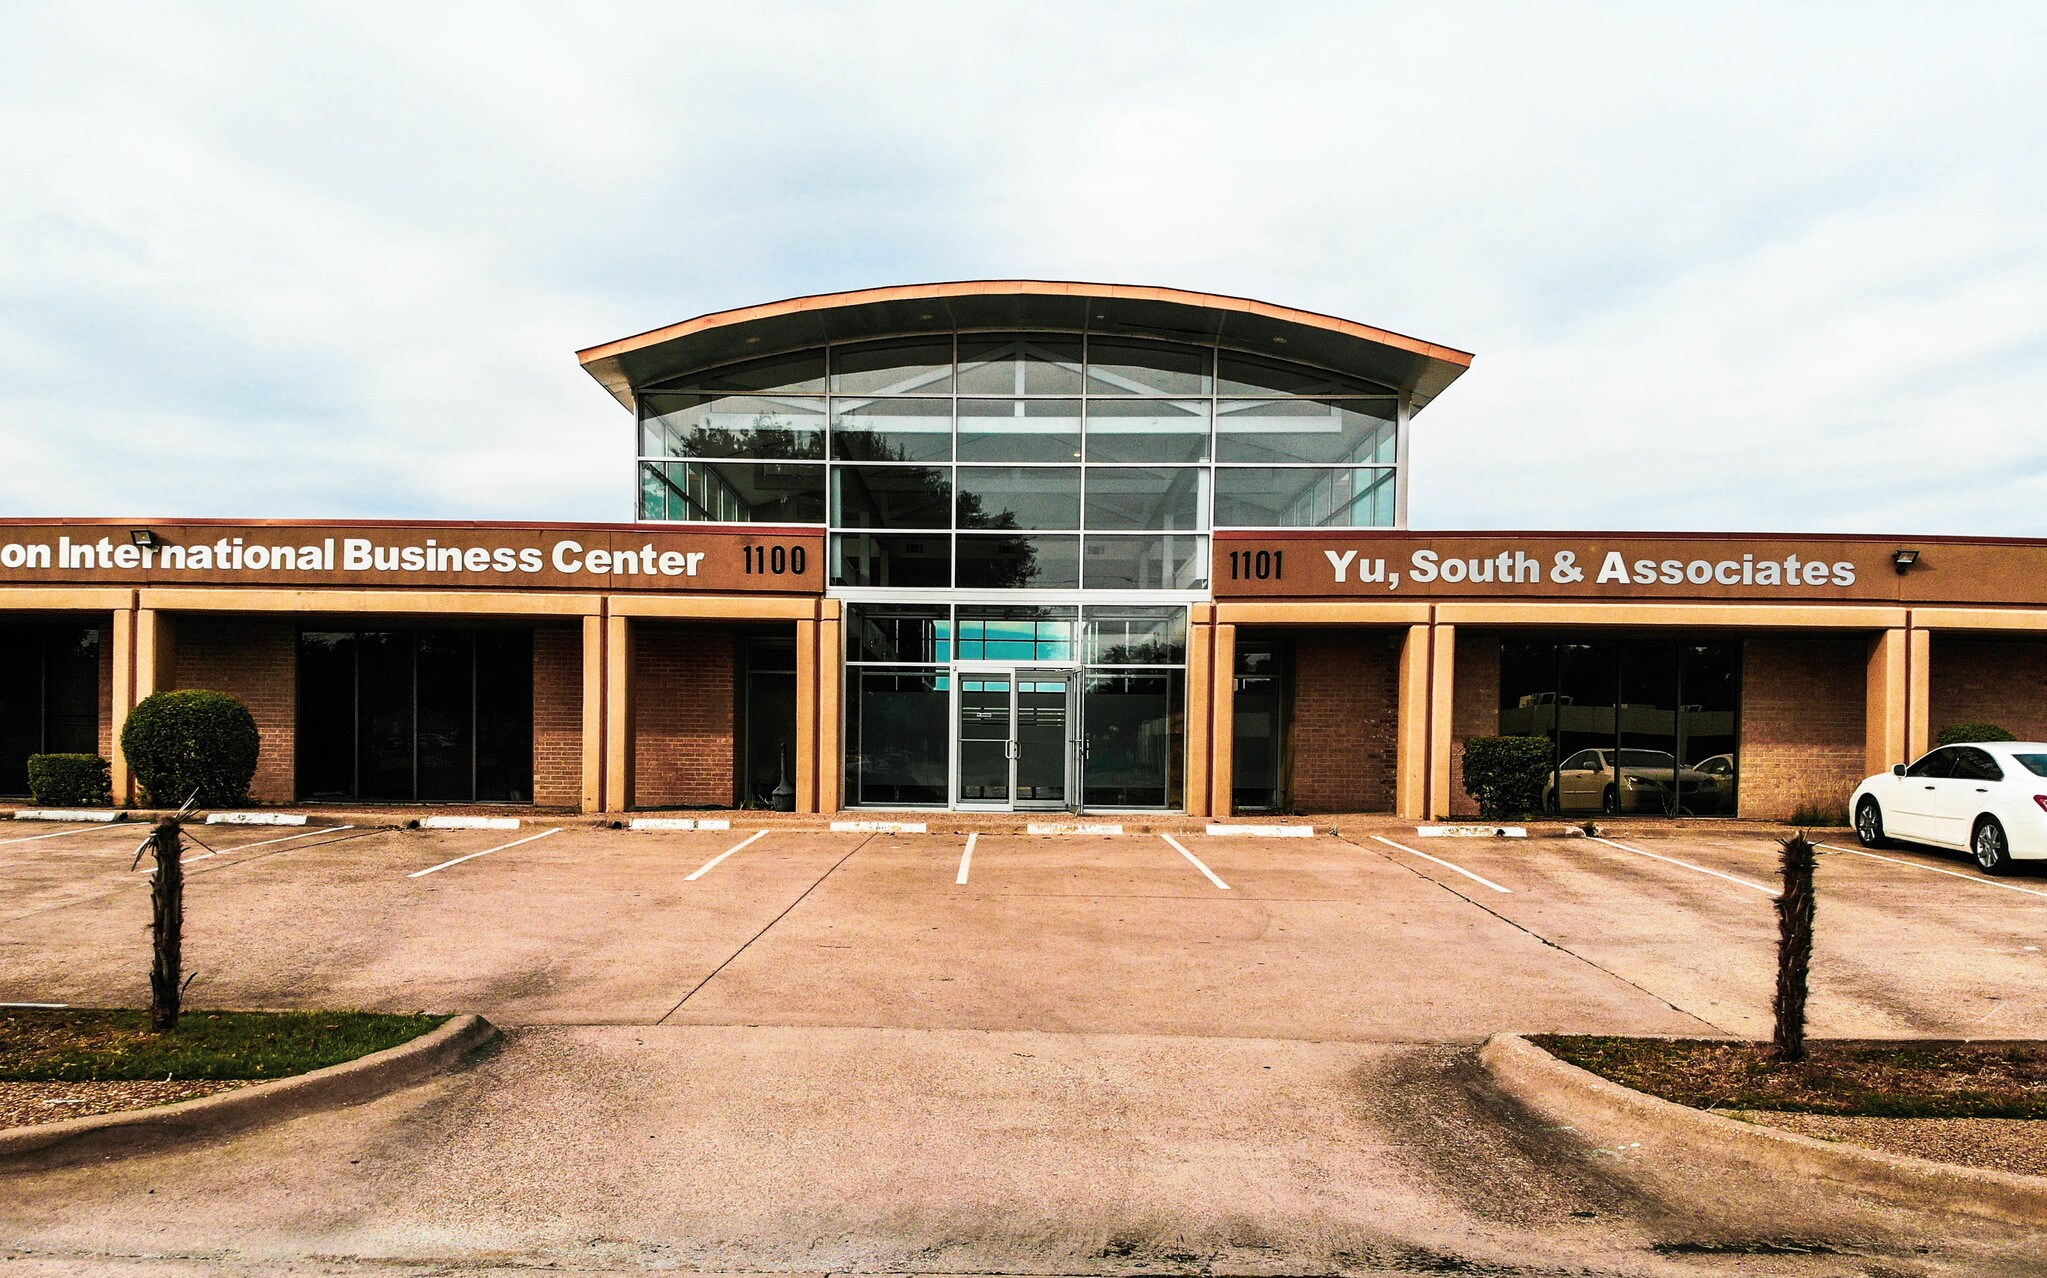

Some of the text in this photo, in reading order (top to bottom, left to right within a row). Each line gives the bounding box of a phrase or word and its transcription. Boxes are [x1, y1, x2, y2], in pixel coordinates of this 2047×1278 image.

[1, 536, 706, 576] on International Business Center
[743, 544, 806, 574] 1100
[1229, 550, 1284, 580] 1101
[1323, 549, 1857, 590] Yu, South & Associates
